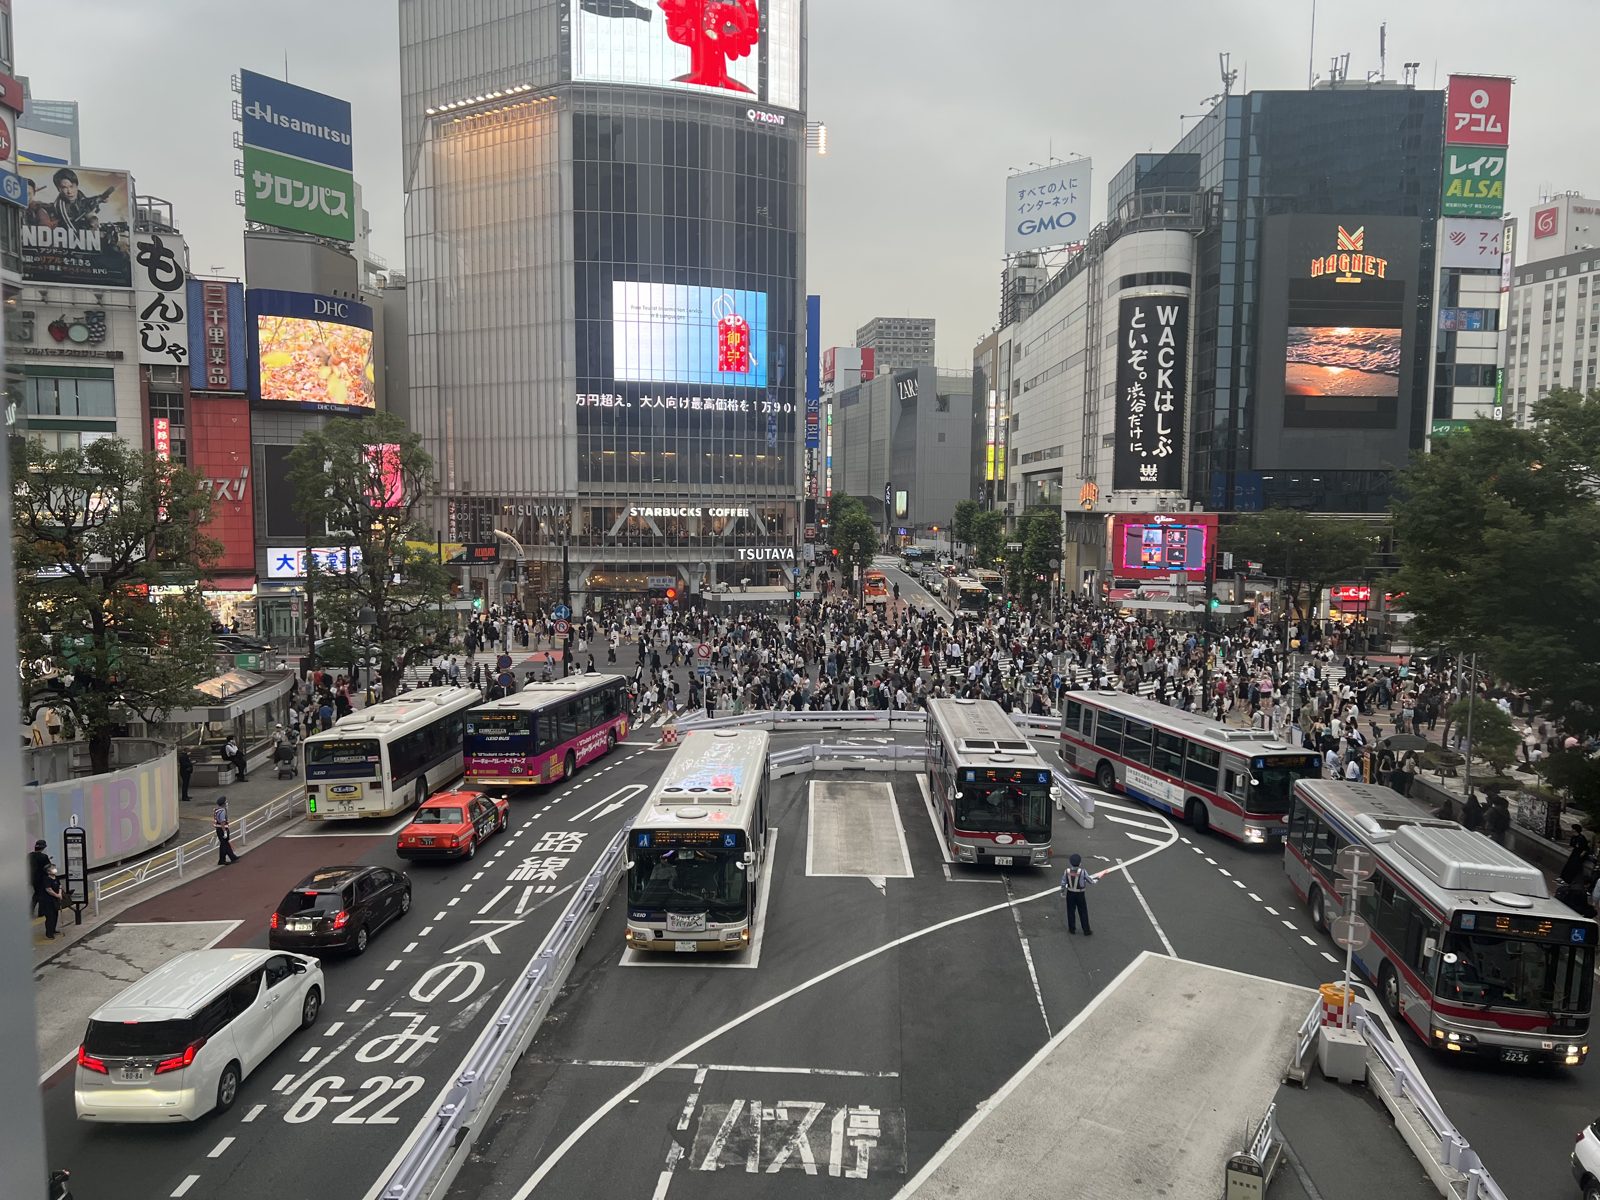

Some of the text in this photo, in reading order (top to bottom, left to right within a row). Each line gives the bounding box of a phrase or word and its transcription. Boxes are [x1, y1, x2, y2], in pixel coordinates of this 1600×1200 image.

[245, 101, 350, 145] Hisamitsu
[1455, 113, 1502, 132] アコム
[1450, 155, 1504, 176] レイク
[4, 177, 19, 199] 6F
[253, 170, 348, 219] サロンパス
[1018, 178, 1078, 200] すべての人に
[1446, 179, 1502, 199] ALSA
[1018, 193, 1077, 214] インターネット
[1018, 211, 1077, 236] GMO
[1311, 253, 1388, 279] MAGNET
[136, 235, 187, 363] もんじゃ
[313, 298, 349, 319] DHC
[727, 331, 740, 361] 御守
[898, 379, 918, 400] ZARA
[510, 505, 564, 516] TSUTAYA
[630, 508, 749, 517] STARBUCKS COFFEE
[738, 548, 795, 560] TSUTAYA
[284, 1076, 425, 1124] 6-22
[700, 1099, 881, 1179] バス停
